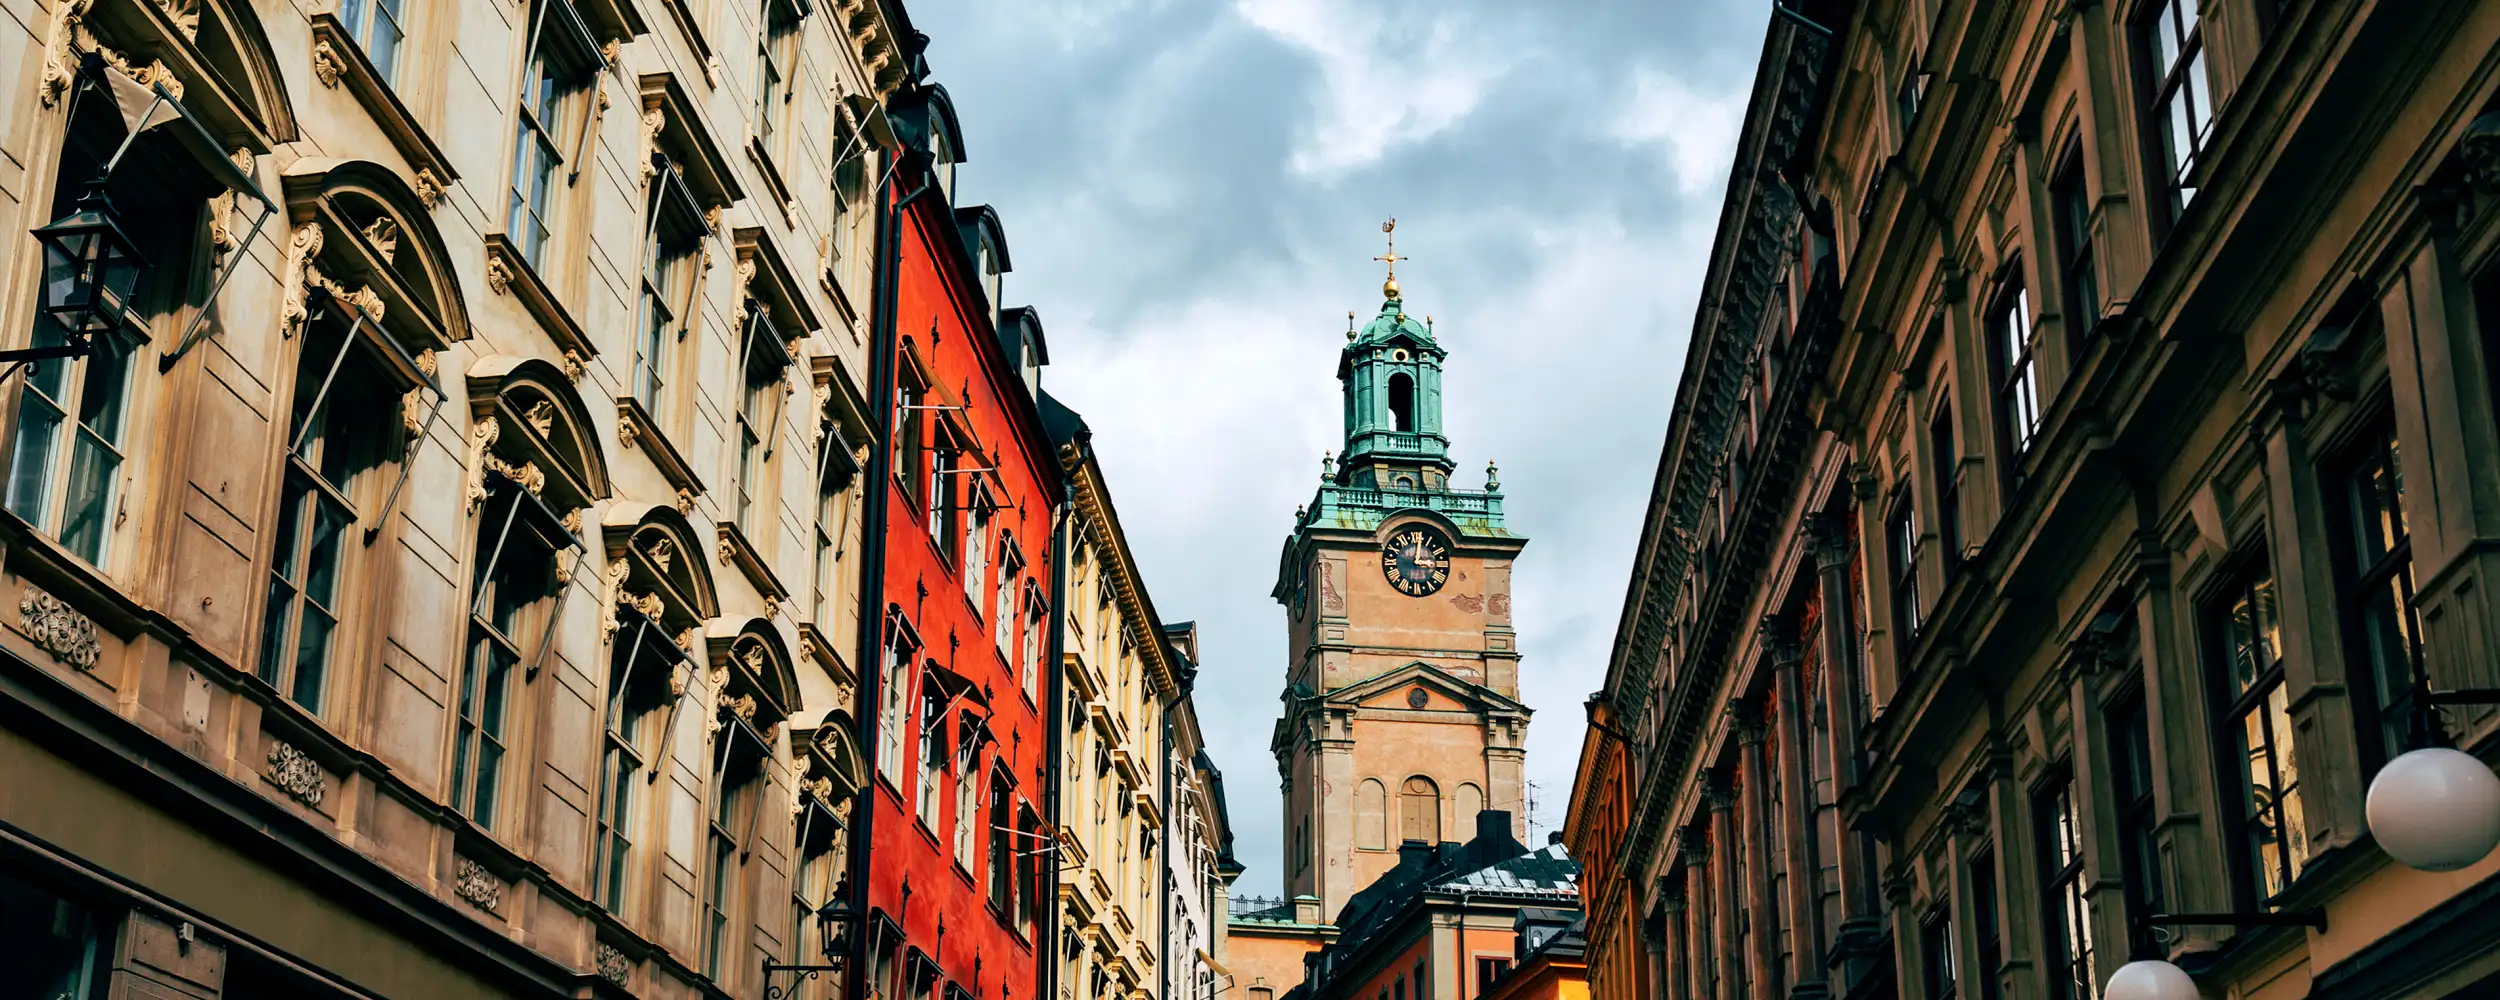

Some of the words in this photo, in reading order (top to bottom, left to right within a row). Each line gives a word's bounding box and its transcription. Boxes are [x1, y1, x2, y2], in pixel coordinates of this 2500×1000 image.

[1396, 534, 1408, 547] XI
[1410, 532, 1422, 544] XI
[1425, 536, 1433, 546] I
[1388, 544, 1400, 554] X
[1432, 547, 1444, 555] II
[1384, 557, 1396, 566] IX
[1414, 583, 1421, 594] VI
[1426, 581, 1435, 591] V
